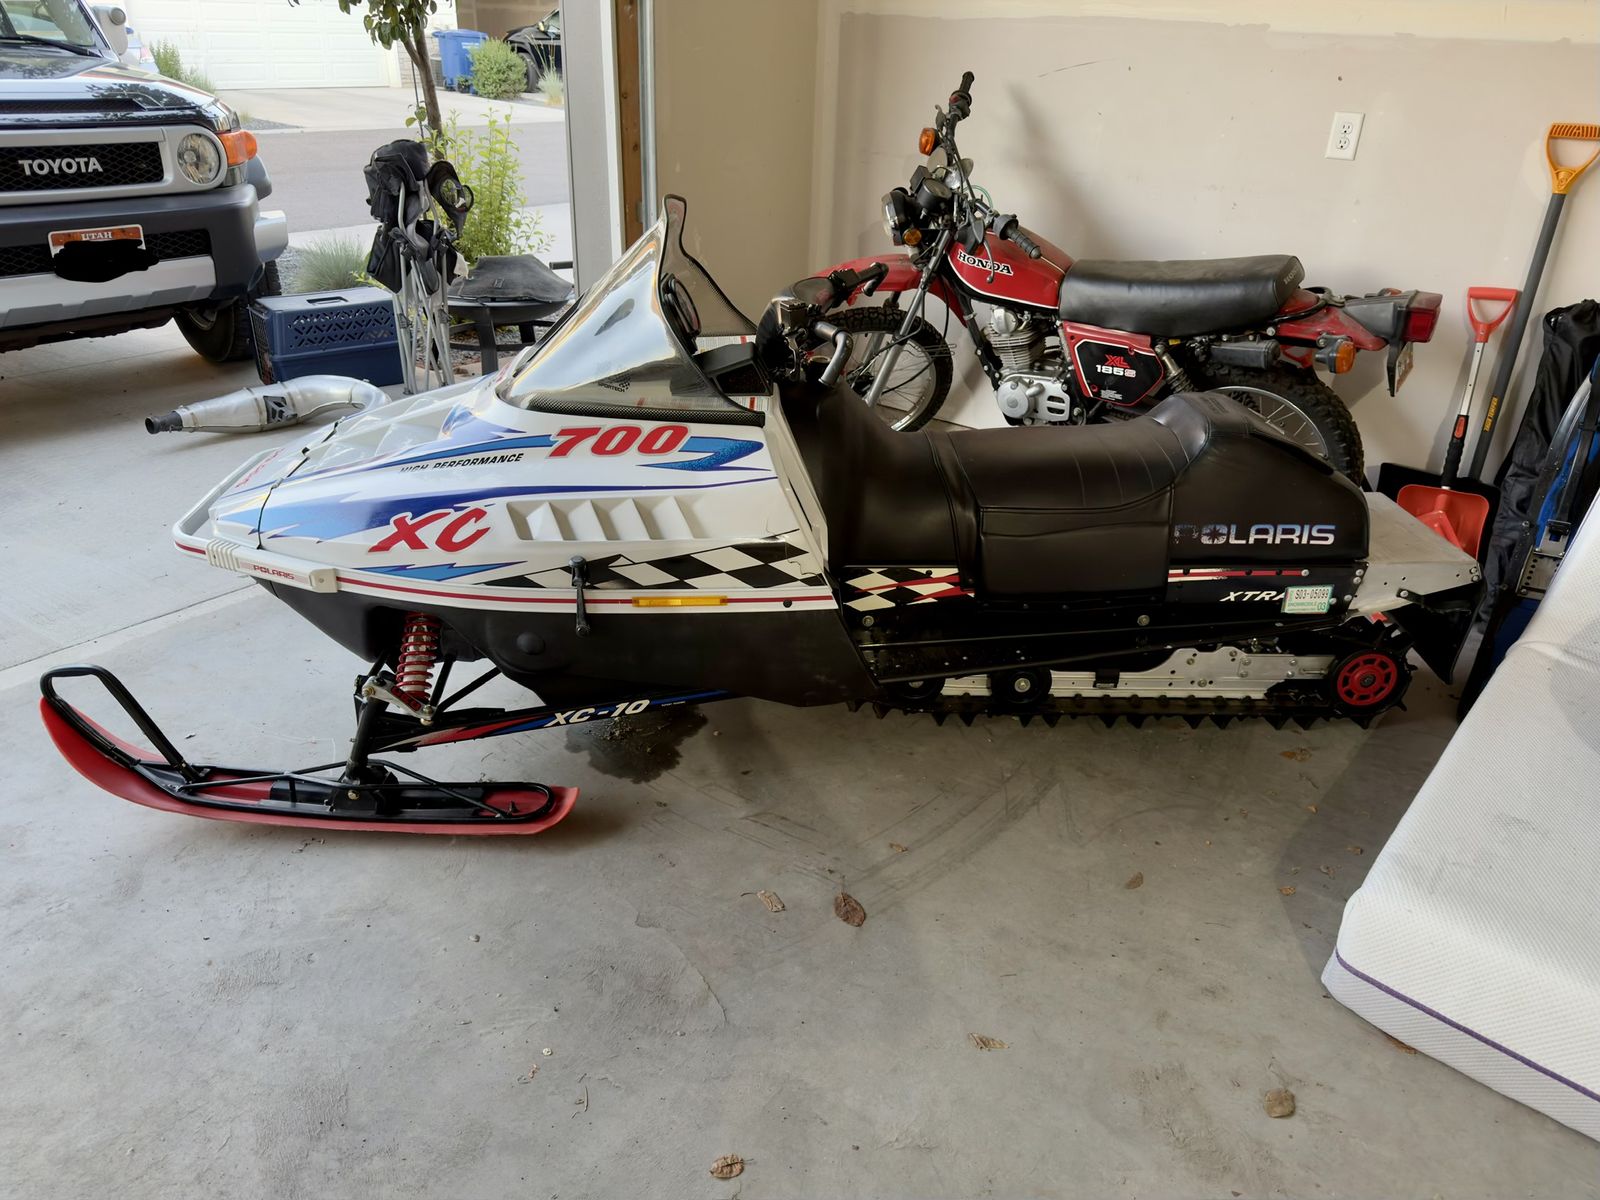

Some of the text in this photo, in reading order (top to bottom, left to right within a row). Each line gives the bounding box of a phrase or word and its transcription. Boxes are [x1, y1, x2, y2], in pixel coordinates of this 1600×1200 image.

[18, 157, 103, 176] TOYOTA
[80, 232, 112, 241] UTAH
[958, 250, 1013, 275] HONDA
[1104, 354, 1130, 369] XL
[548, 425, 689, 459] 700
[433, 453, 524, 470] PERFORMANCE
[368, 507, 491, 553] XC
[253, 564, 295, 580] POLARIS
[544, 699, 650, 727] XC-10
